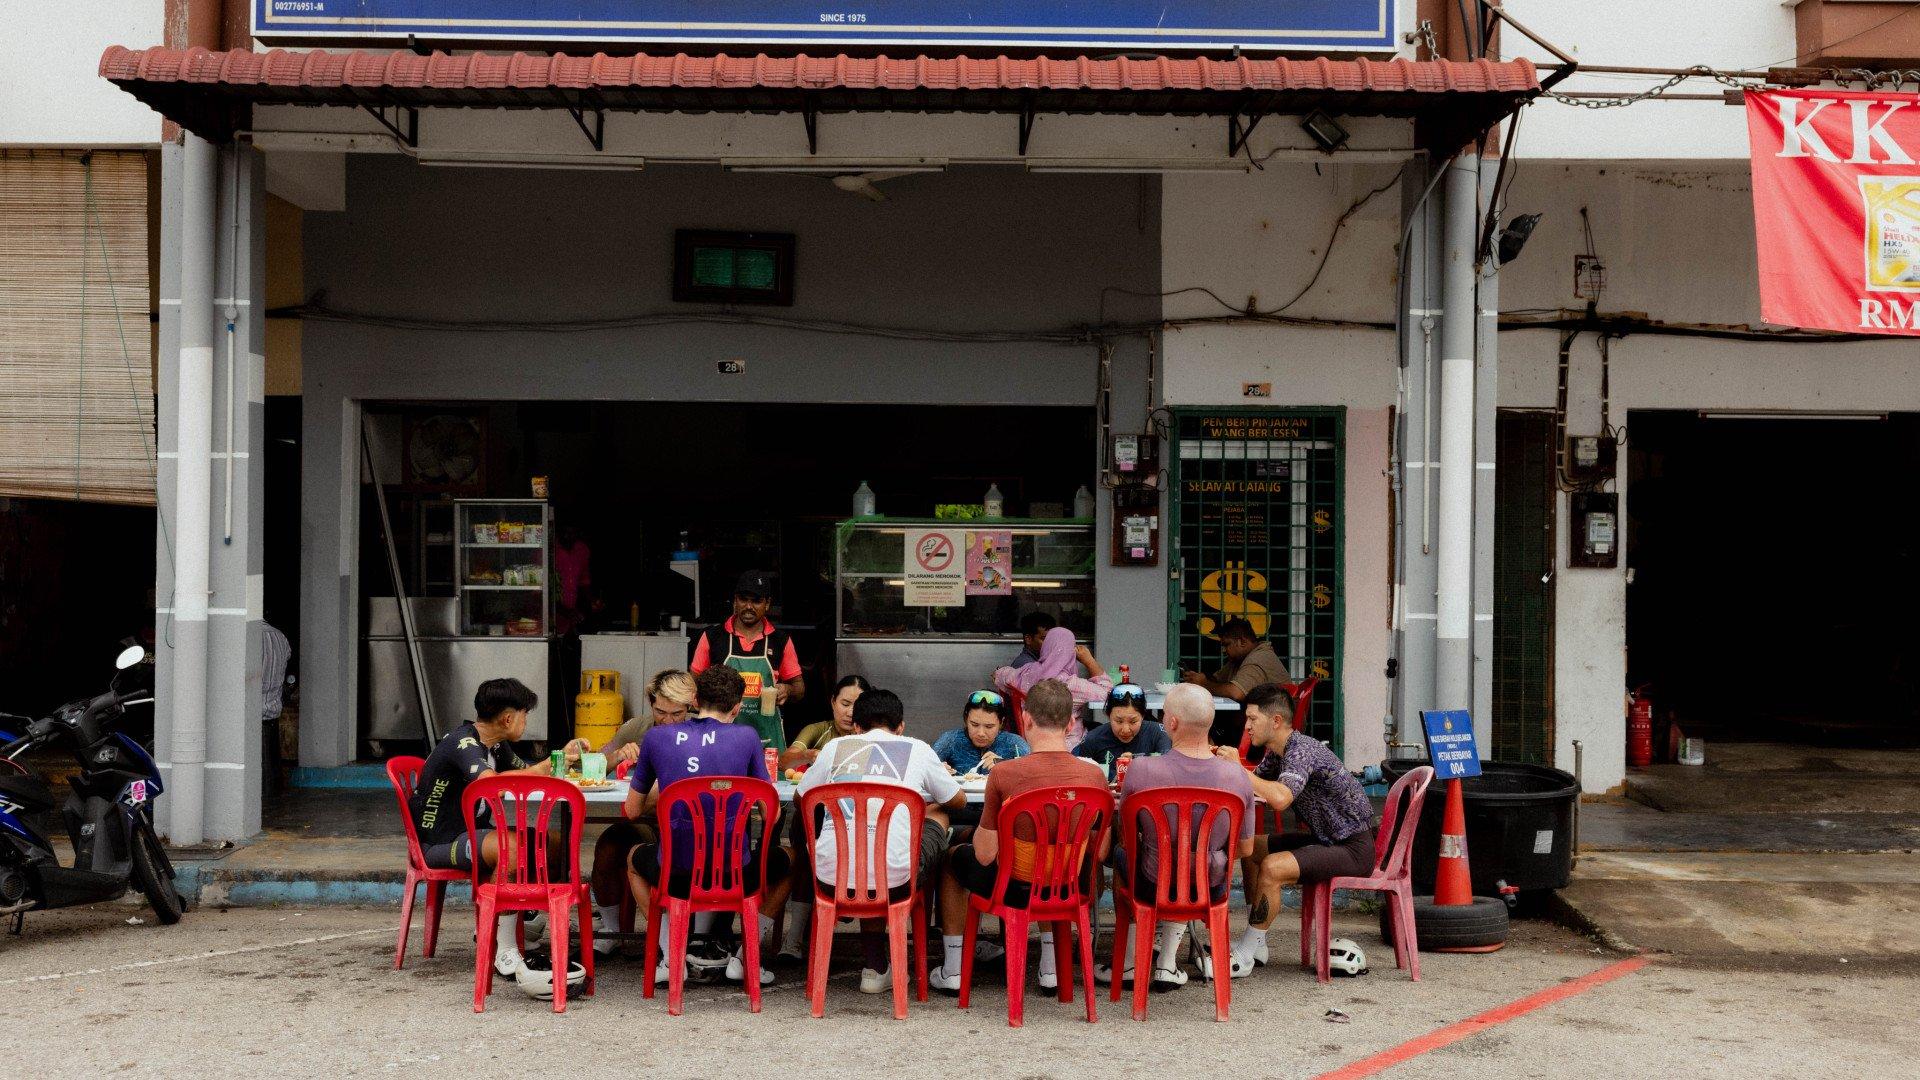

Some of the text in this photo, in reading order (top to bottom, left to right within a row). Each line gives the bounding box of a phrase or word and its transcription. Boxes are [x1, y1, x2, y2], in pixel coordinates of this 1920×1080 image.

[275, 2, 324, 11] 002776951-M
[820, 13, 867, 23] SINCE 1975
[1770, 95, 1920, 165] KK
[1858, 298, 1920, 330] RM
[725, 362, 737, 372] 28
[1248, 428, 1299, 438] BERESEN
[676, 730, 716, 747] P N
[686, 756, 700, 773] S
[847, 763, 885, 775] P N
[421, 778, 450, 829] SOLITUDE
